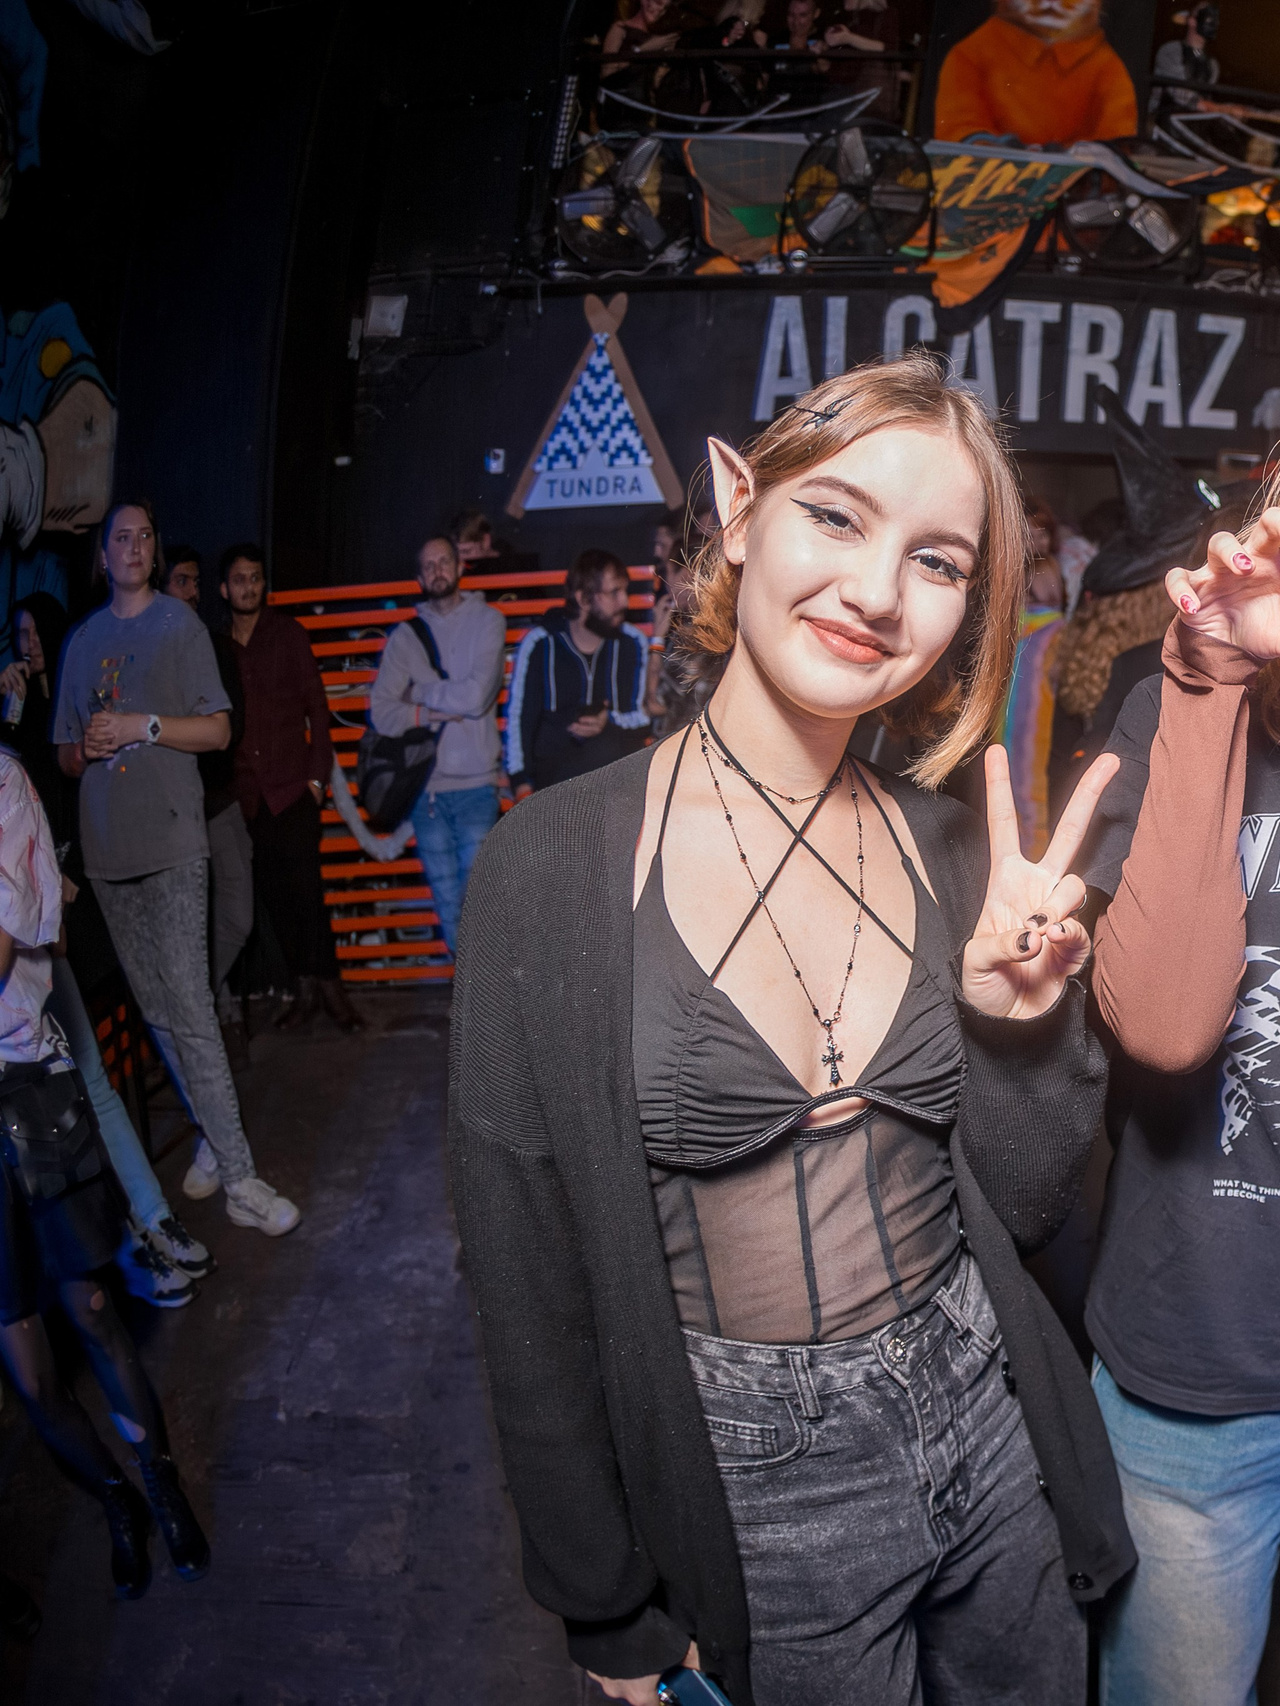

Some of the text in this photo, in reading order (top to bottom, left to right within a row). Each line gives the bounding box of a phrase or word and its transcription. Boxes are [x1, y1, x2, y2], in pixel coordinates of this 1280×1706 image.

[546, 475, 643, 498] TUNDRA
[1213, 1179, 1240, 1188] WHAT
[1241, 1182, 1257, 1192] WE
[1212, 1188, 1266, 1203] WE BECOME
